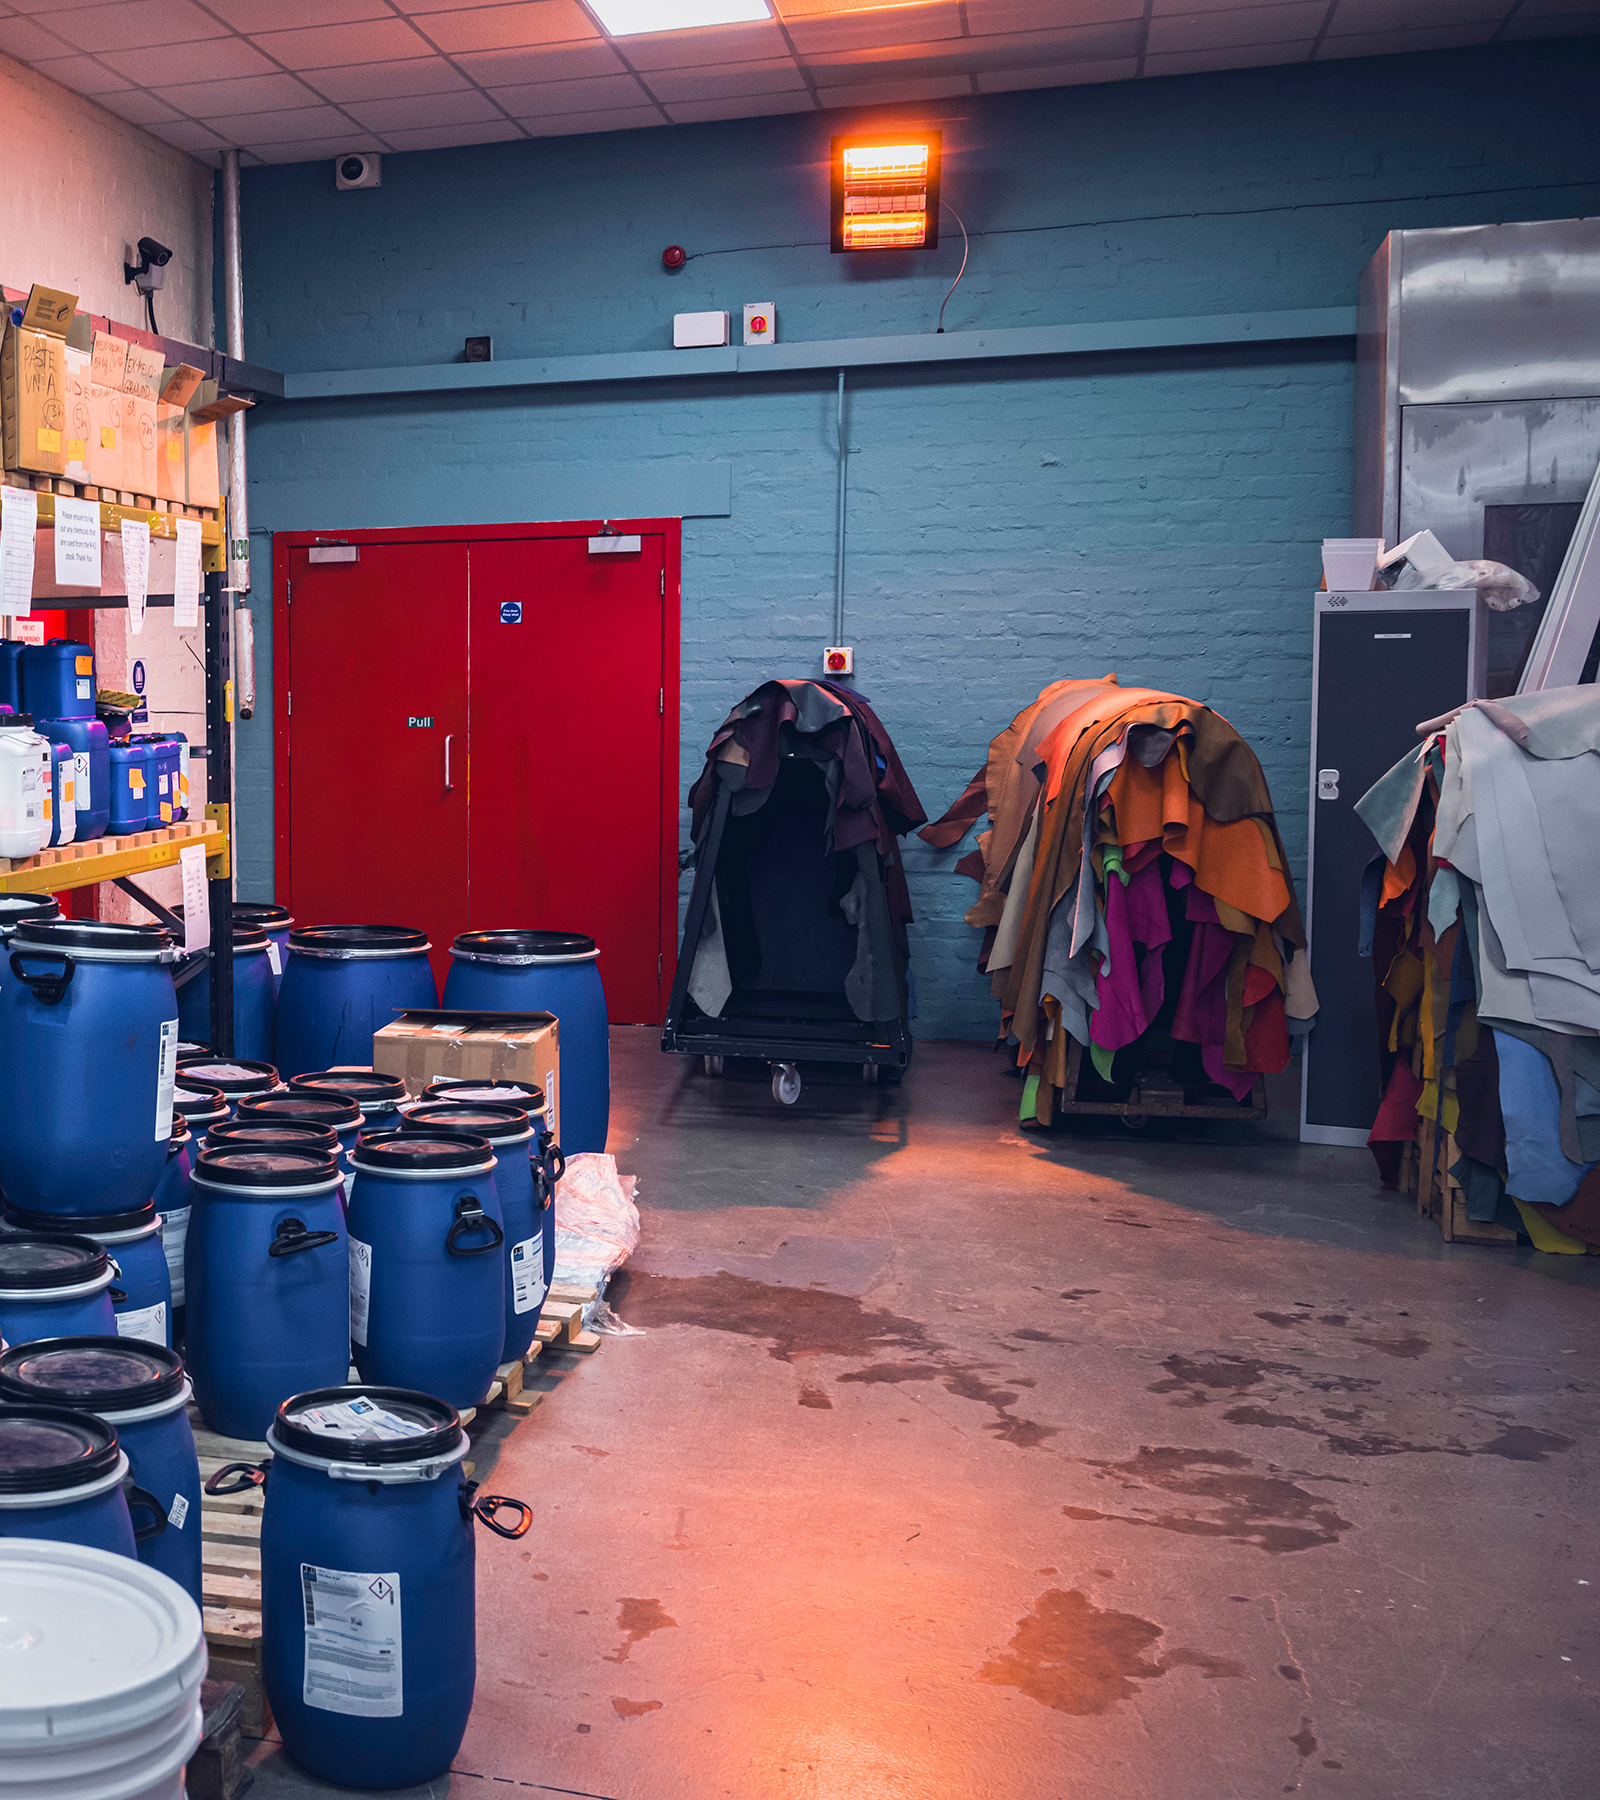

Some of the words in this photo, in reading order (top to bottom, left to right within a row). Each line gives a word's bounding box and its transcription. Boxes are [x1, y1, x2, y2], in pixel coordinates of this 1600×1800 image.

[24, 345, 58, 374] PASTE
[61, 511, 73, 520] Please
[73, 513, 84, 522] ensure
[73, 526, 89, 536] chemicals
[67, 540, 75, 548] used
[75, 540, 84, 548] from
[75, 553, 86, 562] Thank
[408, 716, 431, 728] Pull
